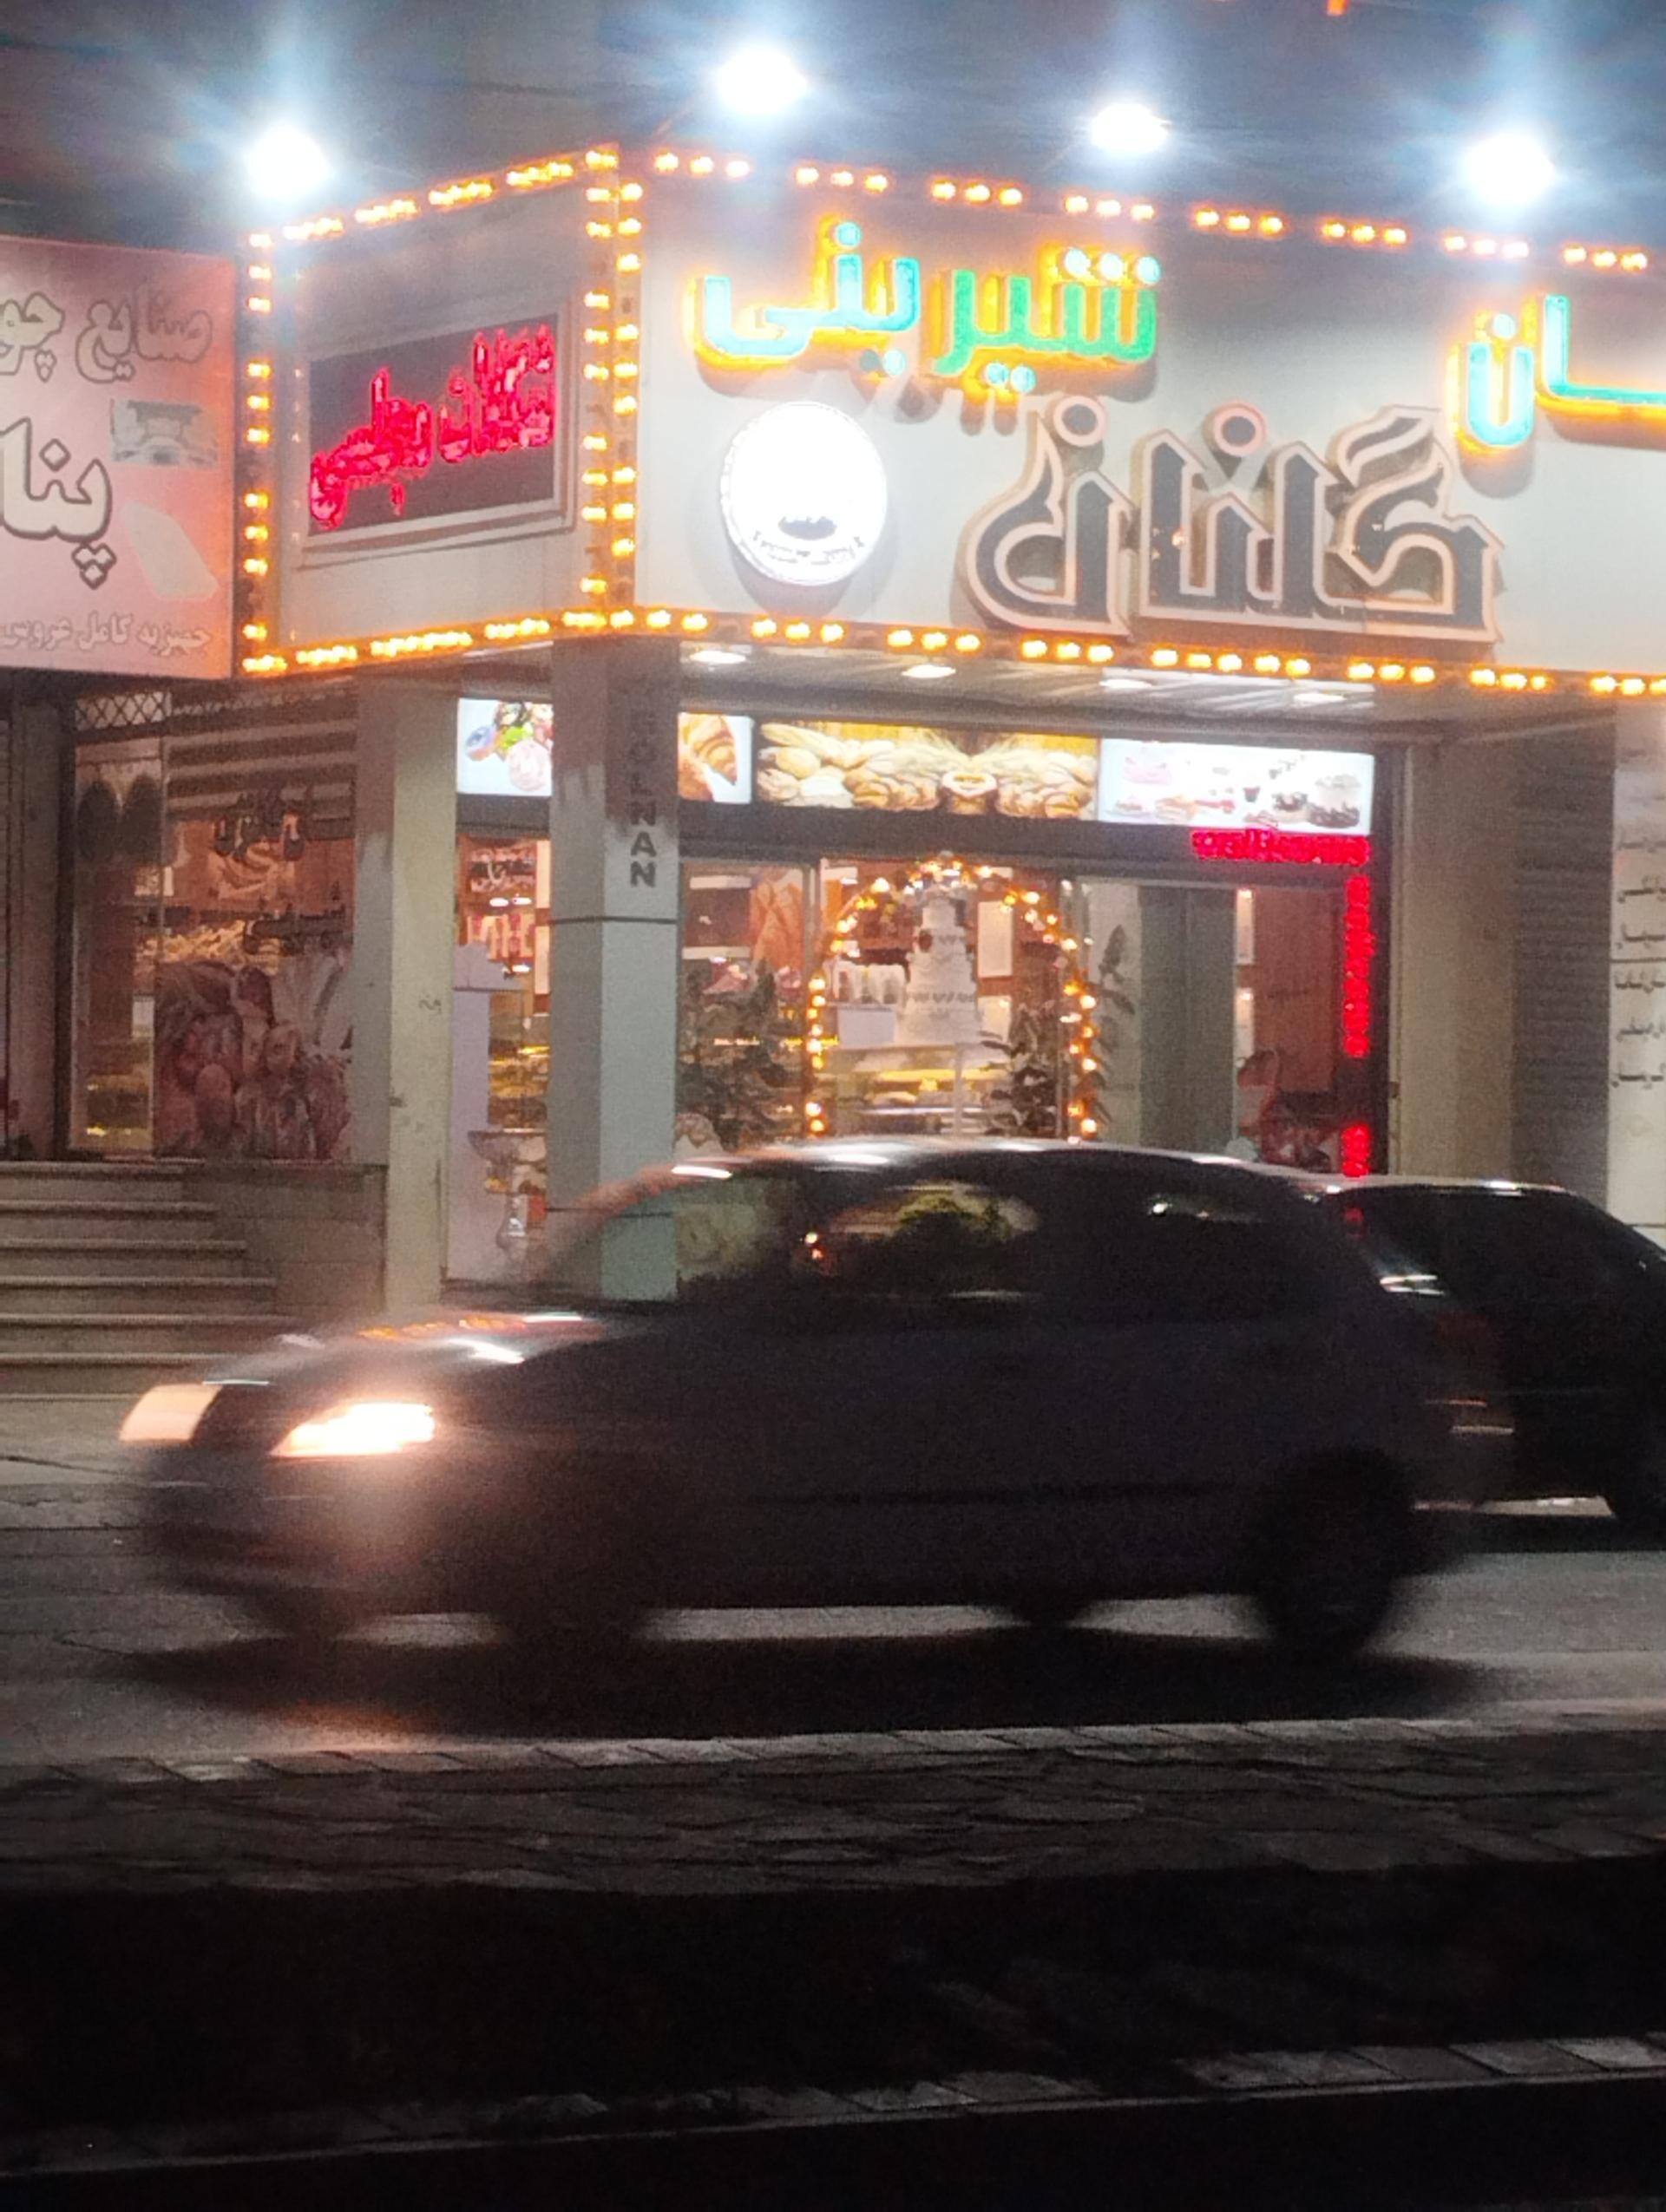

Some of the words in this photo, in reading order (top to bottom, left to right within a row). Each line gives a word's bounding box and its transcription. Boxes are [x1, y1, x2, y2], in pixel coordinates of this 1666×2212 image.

[0, 291, 65, 382] چو
[75, 284, 214, 383] صنایع
[692, 219, 1164, 393] شیرینی
[76, 609, 134, 651] کامل
